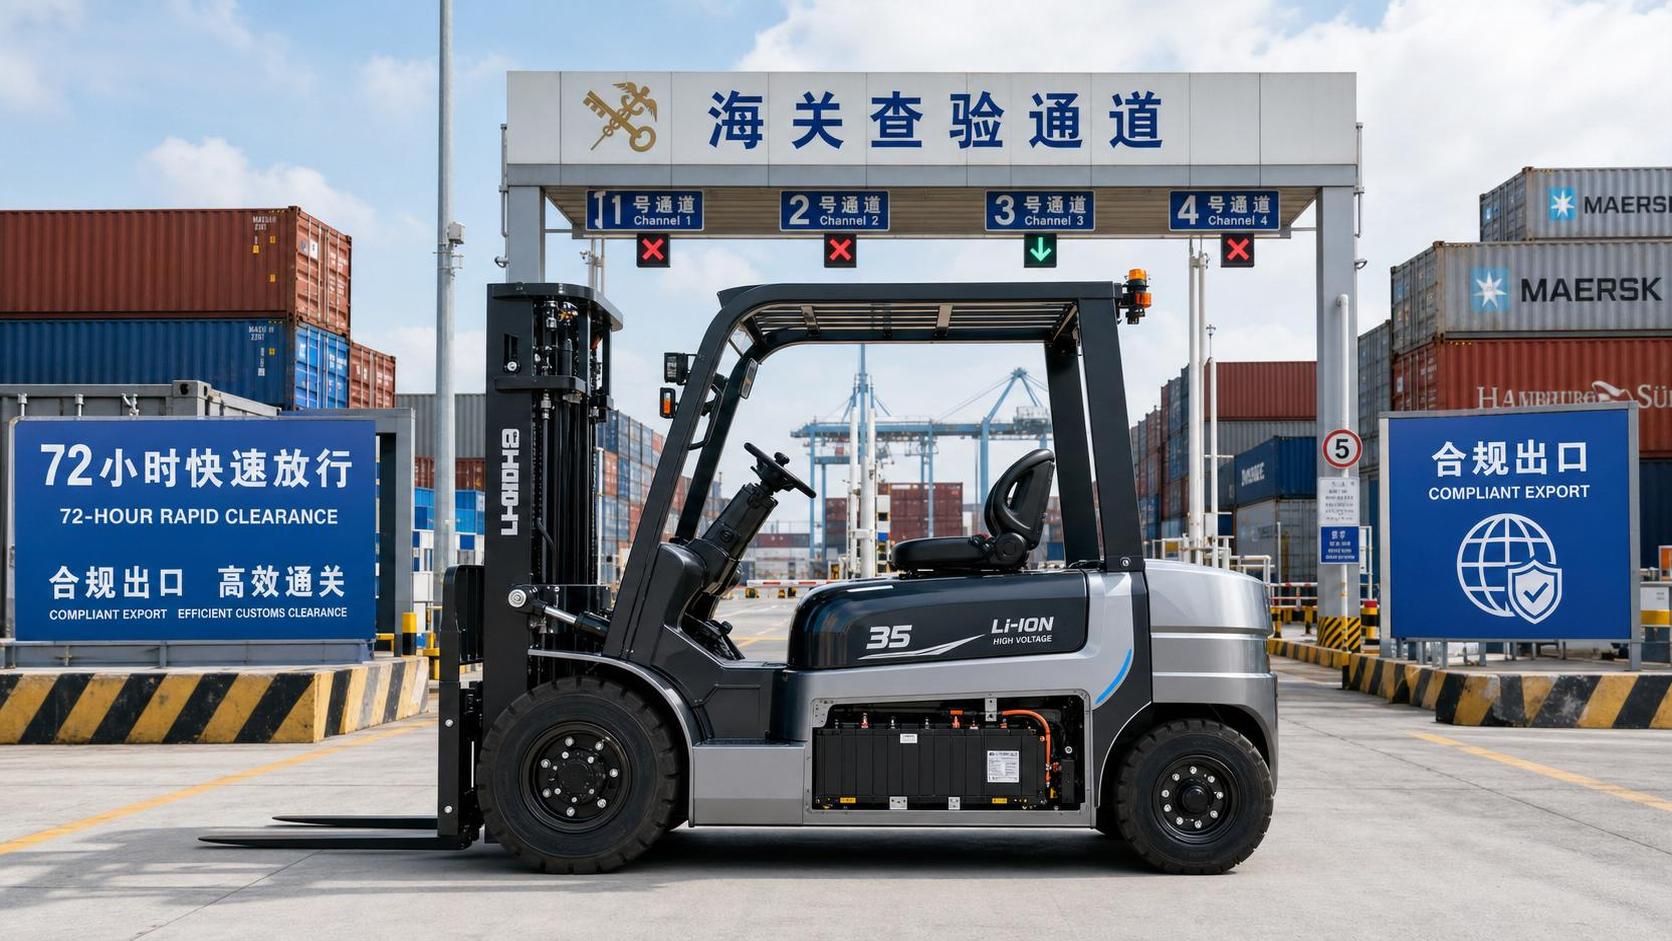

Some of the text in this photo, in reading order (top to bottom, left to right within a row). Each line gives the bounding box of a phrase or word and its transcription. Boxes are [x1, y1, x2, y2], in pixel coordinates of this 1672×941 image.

[708, 90, 1163, 149] 海关查验通道
[788, 195, 809, 225] 2
[994, 195, 1016, 226] 3
[1177, 195, 1200, 225] 4
[1584, 195, 1672, 215] MAERS
[634, 215, 691, 226] Channel 1
[819, 215, 879, 226] Channel 2
[1024, 215, 1084, 226] Channel 3
[1208, 215, 1268, 226] Channel 4
[1521, 277, 1663, 302] MAERSK
[1637, 384, 1672, 409] Sü
[1335, 438, 1350, 460] 5
[1431, 439, 1588, 477] 合规出口
[40, 444, 353, 488] 72小时快速放行
[1428, 484, 1590, 501] COMPLIANT EXPORT
[60, 508, 338, 525] 72-HOUR RAPID CLEARANCE
[49, 564, 345, 600] 合规出口 高效通关
[49, 606, 348, 620] COMPLIANT EXPORT EFFICIENT CUSTOMS CLEARANCE
[991, 616, 1054, 634] Li-ION
[866, 624, 913, 650] 35
[993, 634, 1053, 646] HIGH VOLTAGE
